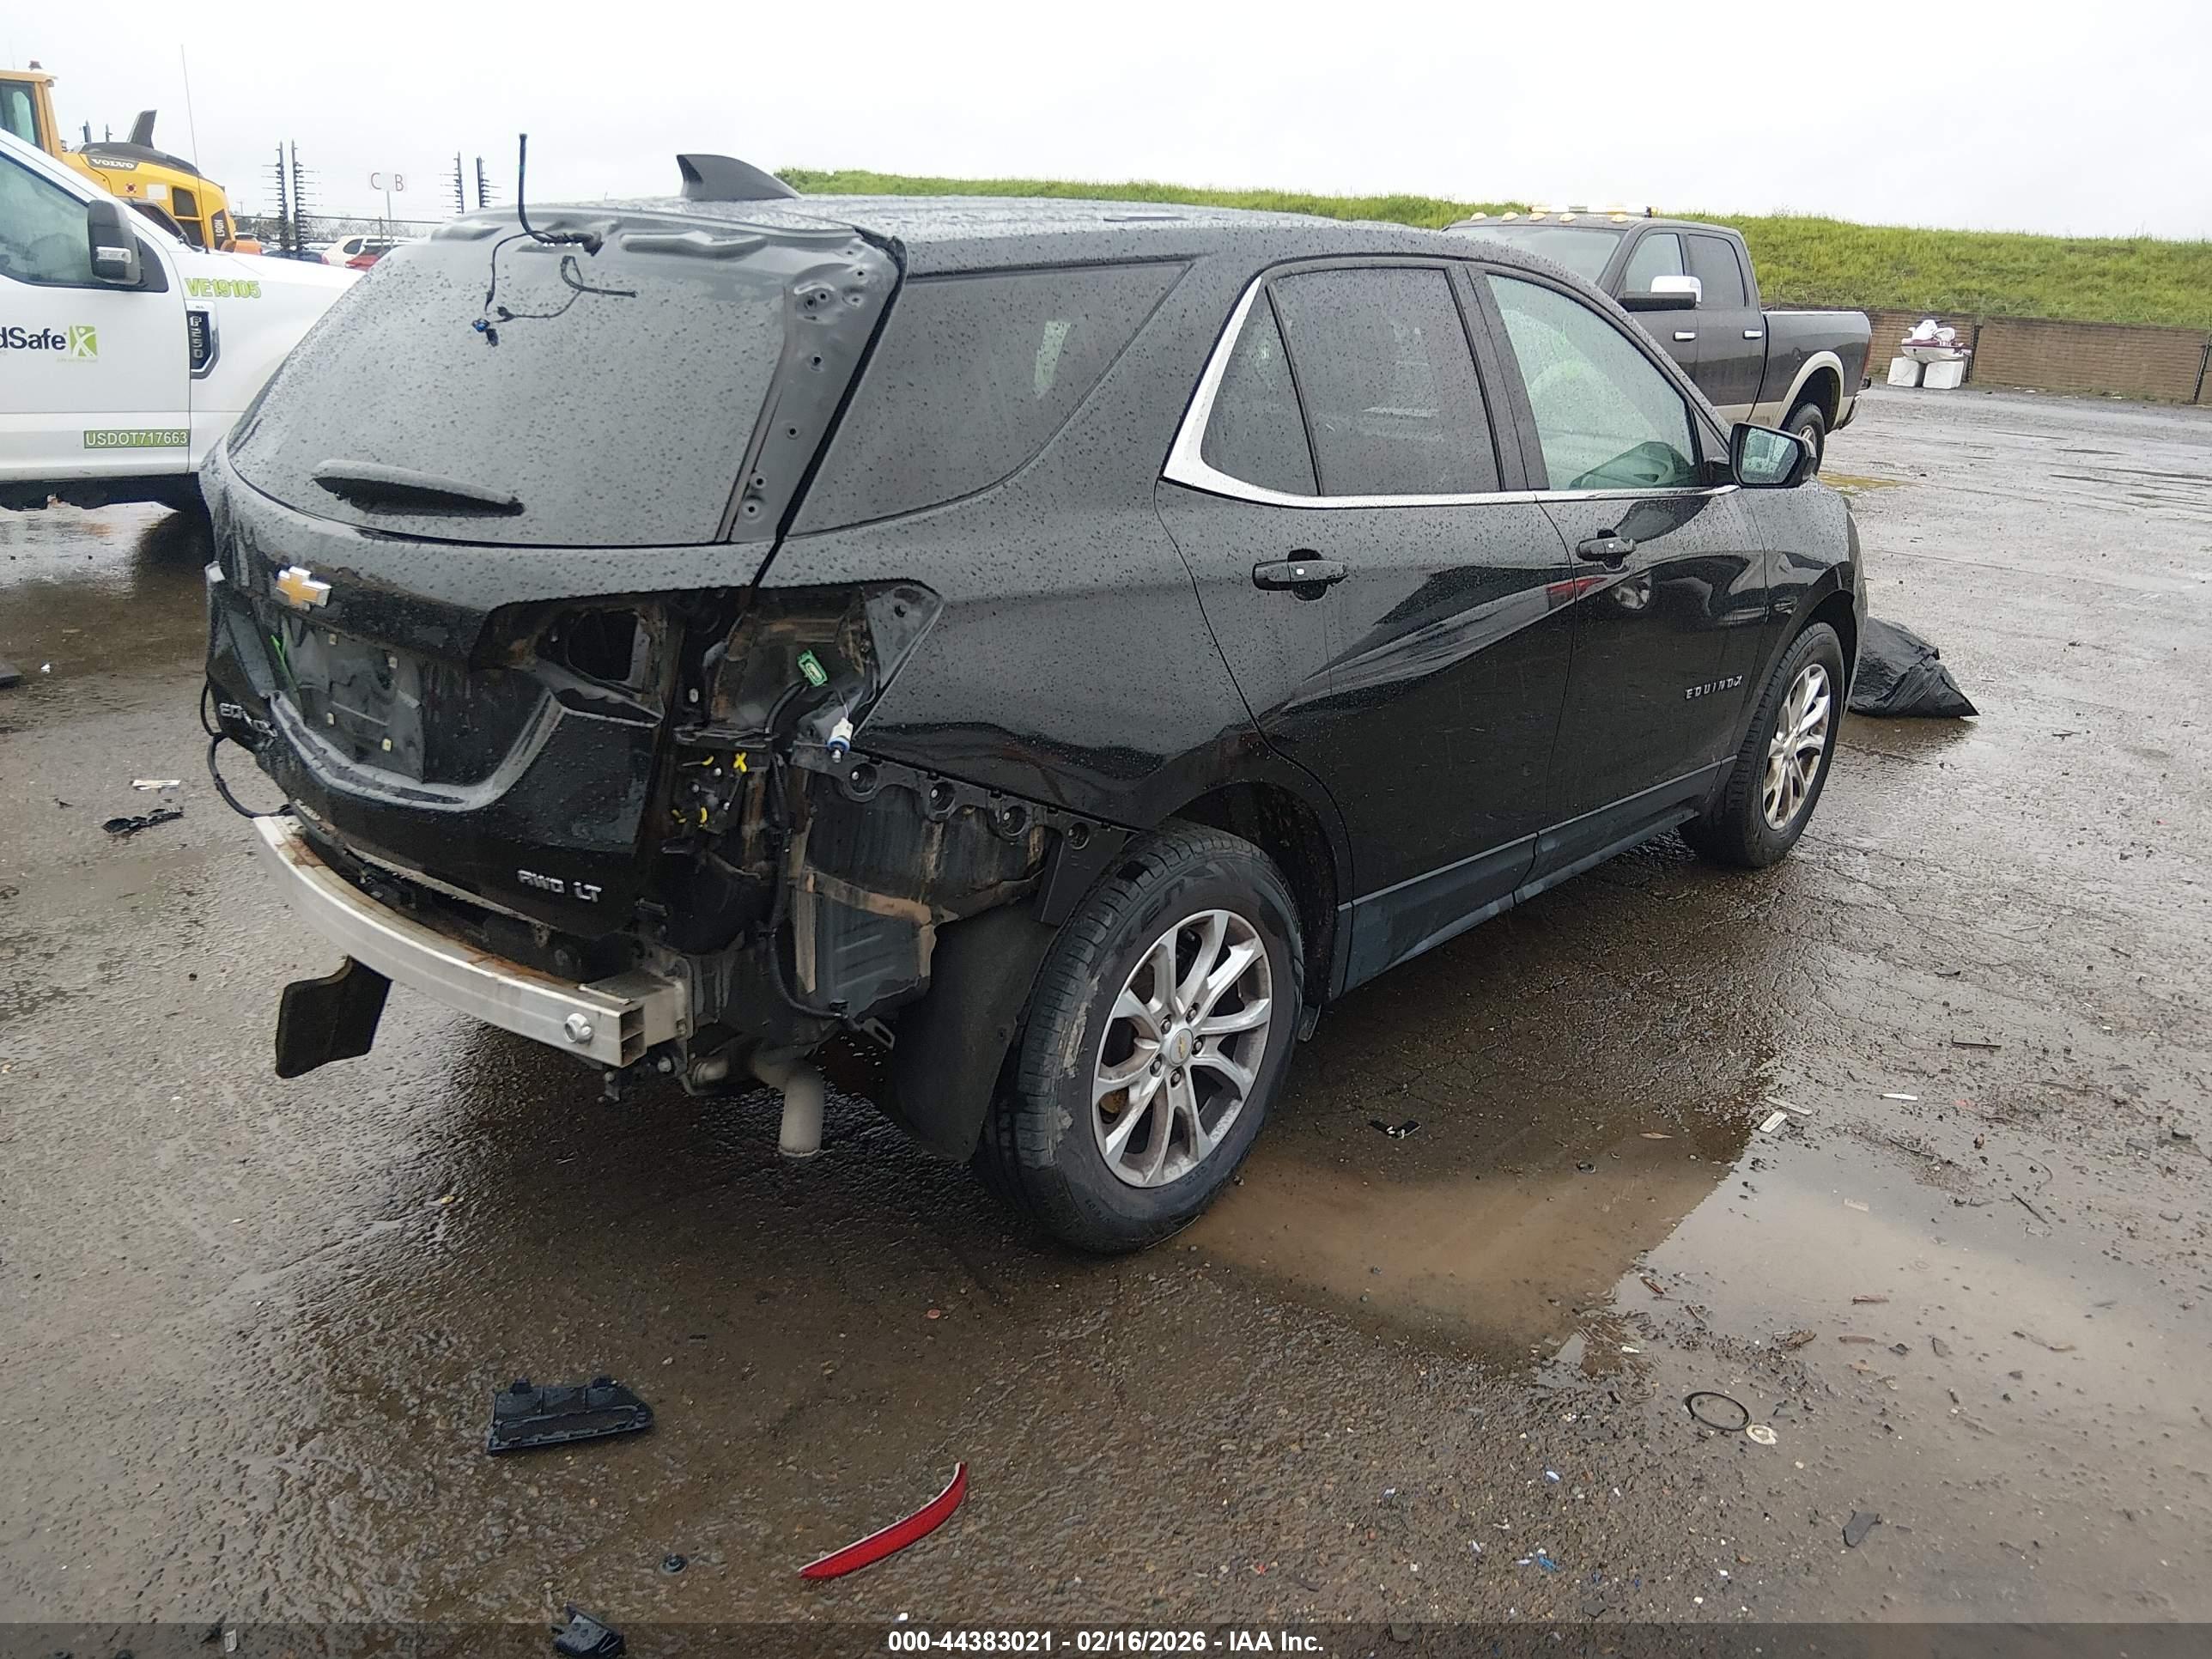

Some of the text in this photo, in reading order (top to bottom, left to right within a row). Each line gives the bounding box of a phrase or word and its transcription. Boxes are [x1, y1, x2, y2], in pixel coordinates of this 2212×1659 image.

[90, 158, 135, 169] VOLVO
[370, 172, 404, 191] C B
[184, 277, 262, 299] VE19105
[85, 431, 188, 446] USDOT717663
[1685, 674, 1743, 700] EQUINOX
[517, 869, 603, 903] AWD LT
